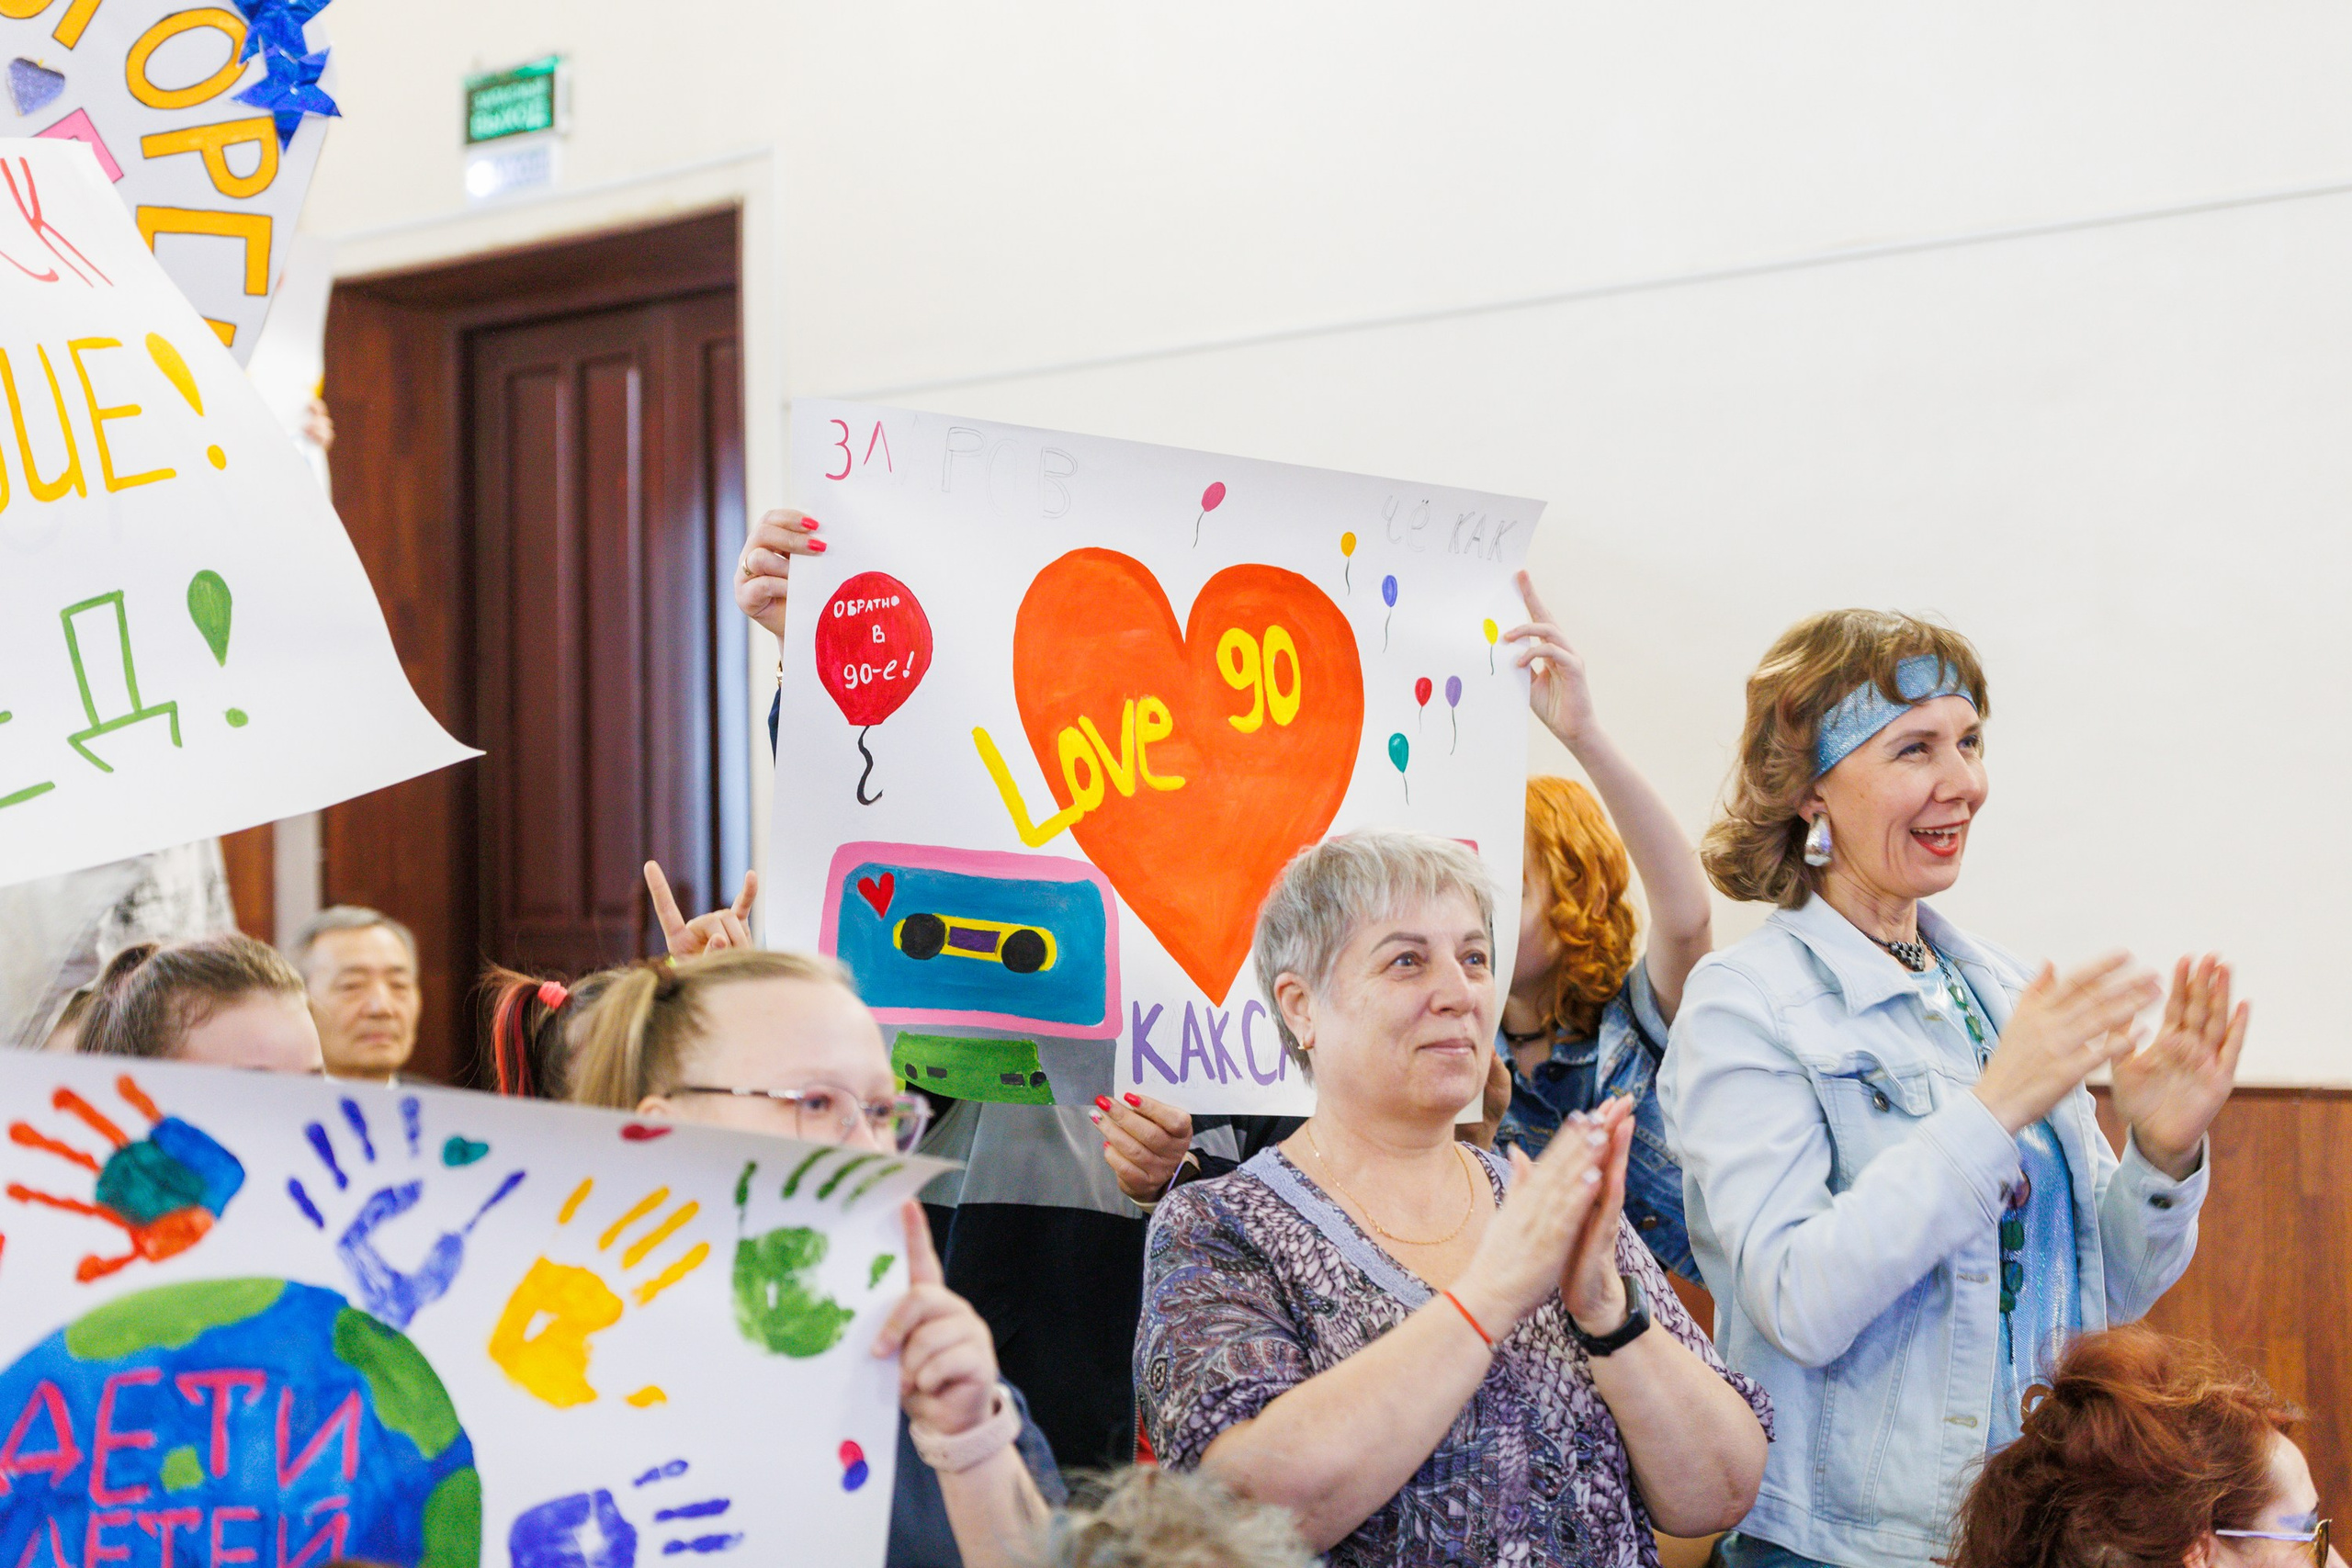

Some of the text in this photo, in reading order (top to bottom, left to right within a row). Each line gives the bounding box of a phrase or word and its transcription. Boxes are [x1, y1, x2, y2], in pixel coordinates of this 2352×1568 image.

[1447, 511, 1518, 563] КАК
[833, 595, 899, 618] ОБРАТНО
[872, 625, 886, 643] В
[1216, 625, 1301, 733] 90
[0, 1367, 364, 1505] ДЕТИ
